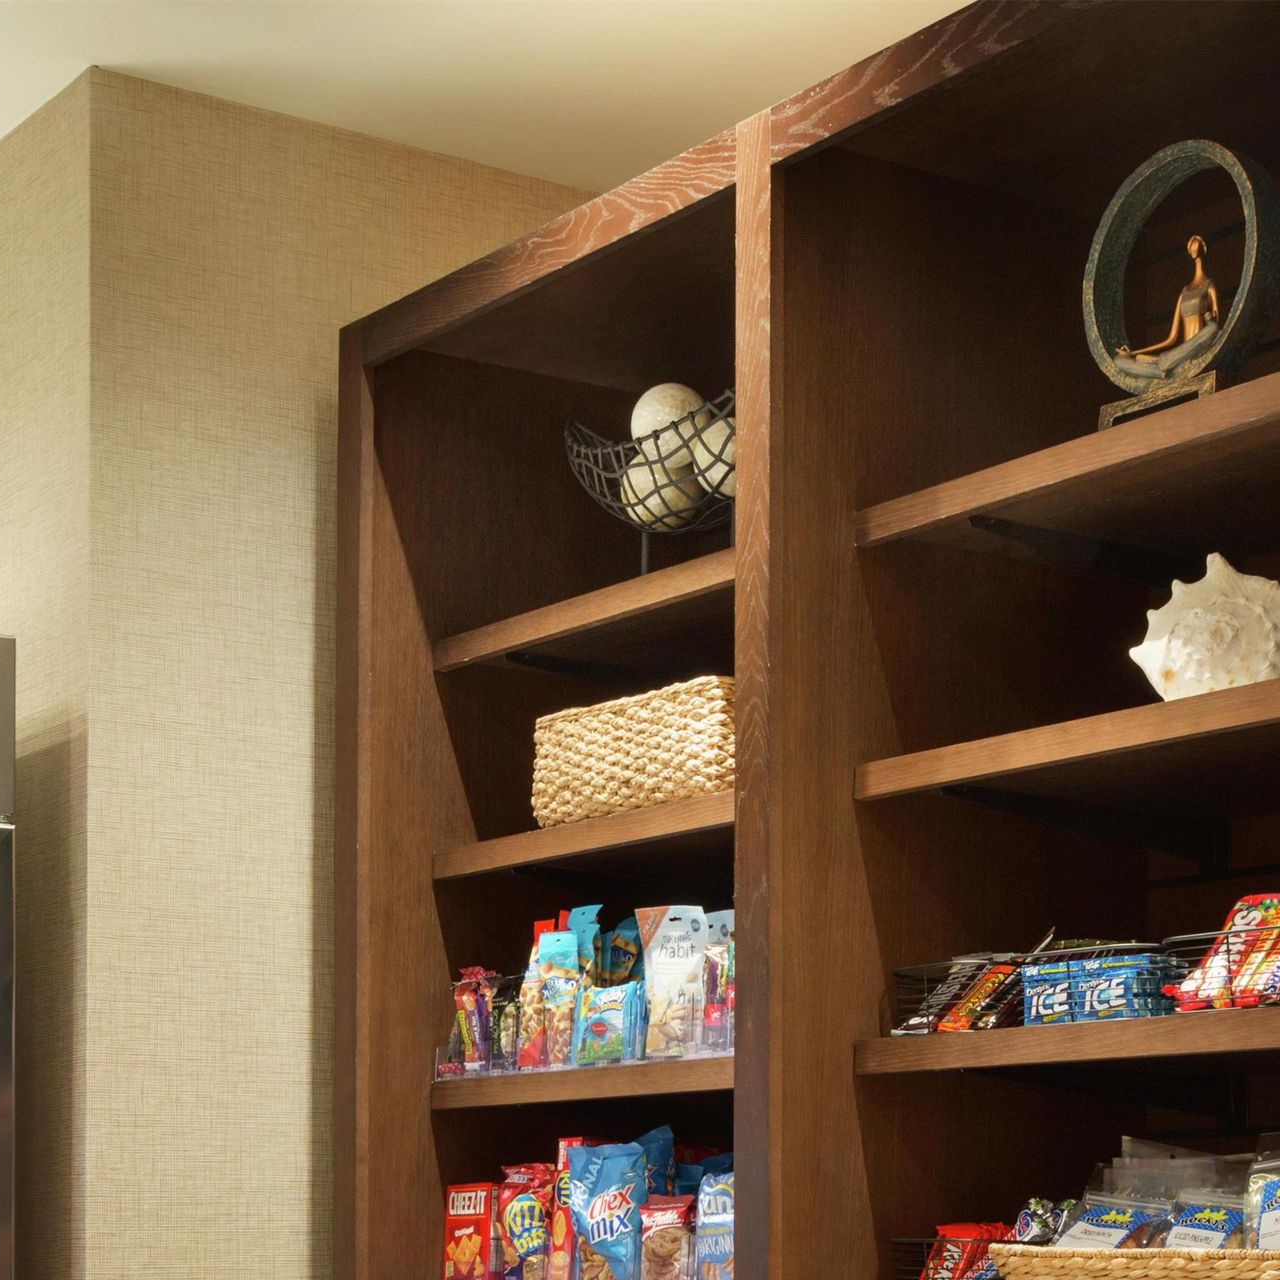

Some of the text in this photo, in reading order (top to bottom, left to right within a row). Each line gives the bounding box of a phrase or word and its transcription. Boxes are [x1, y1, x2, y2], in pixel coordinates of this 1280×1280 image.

[658, 943, 696, 959] habit
[1030, 982, 1070, 1019] ICE
[1084, 975, 1128, 1014] ICE
[449, 1191, 486, 1215] CHEEZ-IT
[588, 1183, 634, 1218] Chex
